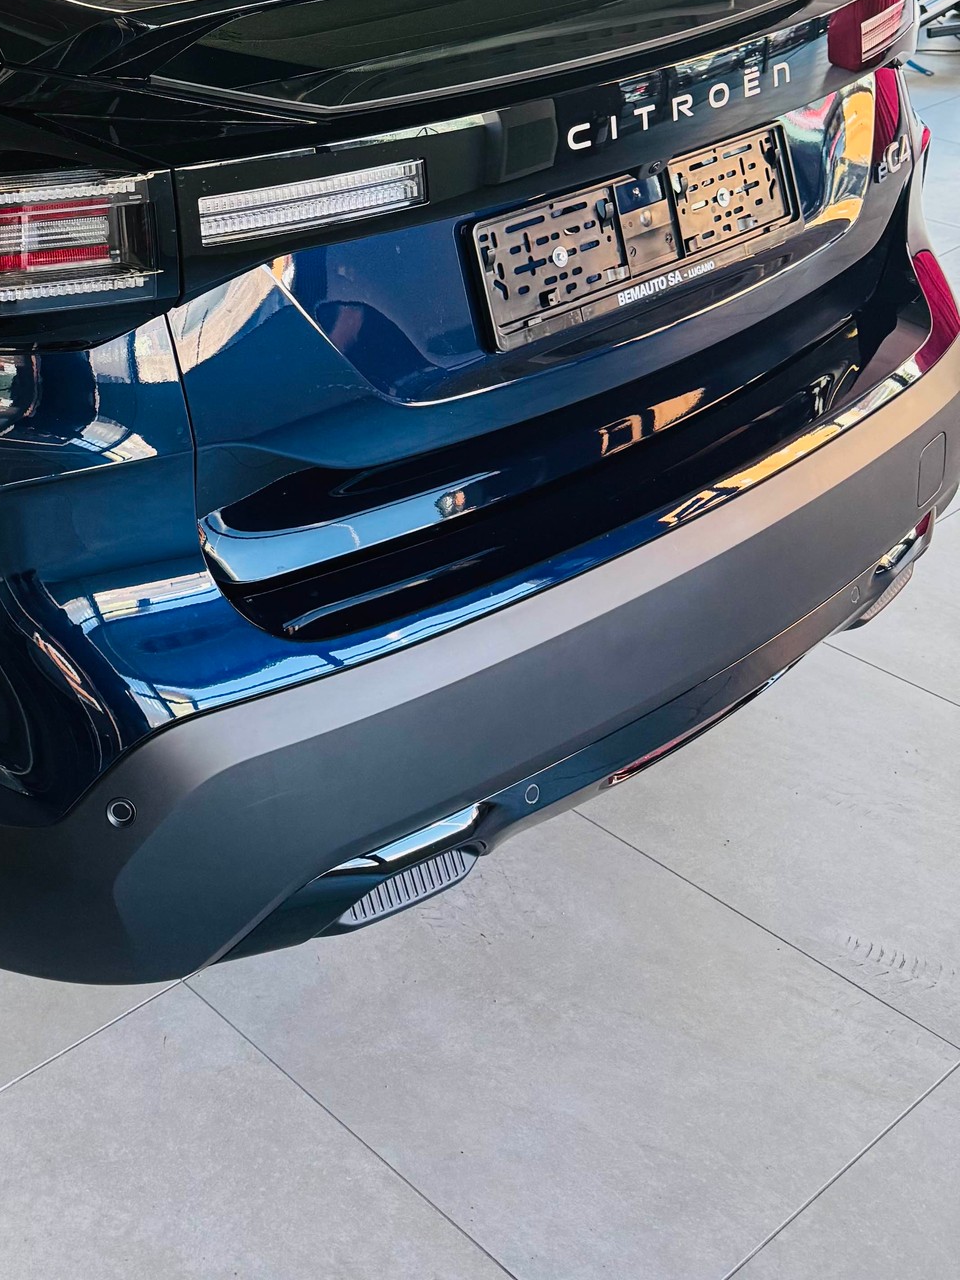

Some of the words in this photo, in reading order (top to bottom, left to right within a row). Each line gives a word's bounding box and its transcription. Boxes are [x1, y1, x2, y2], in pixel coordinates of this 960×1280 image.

[617, 276, 667, 307] BEMAUTO
[667, 270, 683, 287] SA
[688, 260, 715, 278] LUGANO
